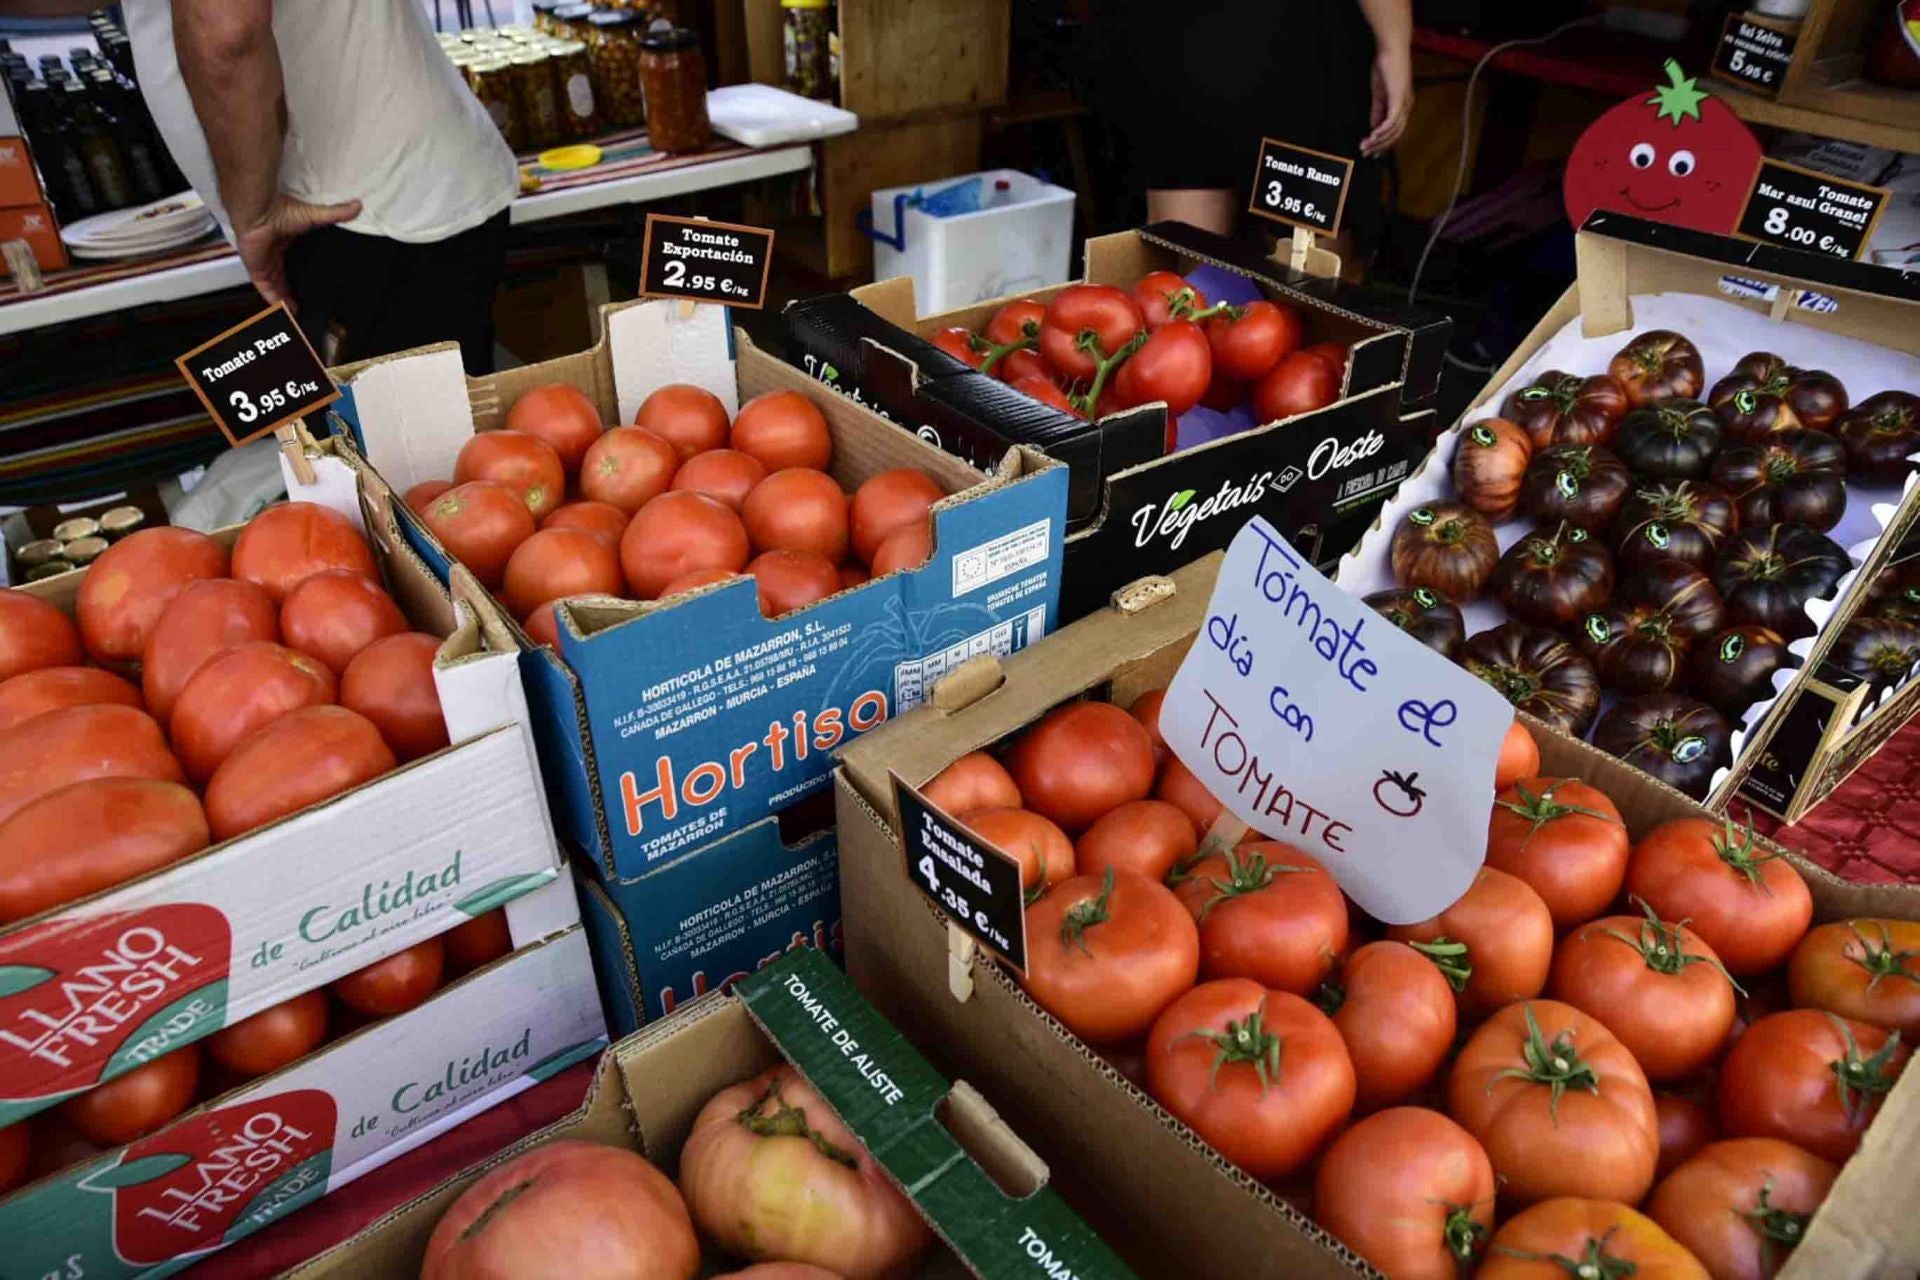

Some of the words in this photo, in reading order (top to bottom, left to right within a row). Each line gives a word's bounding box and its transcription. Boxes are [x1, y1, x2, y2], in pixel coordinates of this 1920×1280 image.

[1265, 155, 1304, 176] Tomate
[1306, 166, 1341, 187] Ramo
[1265, 180, 1302, 213] 3.95
[1818, 185, 1873, 210] Tomate
[1758, 183, 1785, 199] Mar
[1786, 194, 1816, 210] azul
[1818, 202, 1868, 224] Granel
[1764, 207, 1816, 245] 8.00
[662, 242, 754, 264] Exportación
[682, 228, 739, 247] Tomate
[663, 260, 716, 290] 2.95
[202, 349, 257, 383] Tomate
[253, 331, 291, 355] Pera
[229, 388, 286, 422] 3.95
[1131, 472, 1273, 550] Vegetais
[1306, 429, 1386, 481] Oeste
[641, 664, 714, 702] HORTICOLA
[714, 655, 733, 672] DE
[734, 628, 803, 664] MAZARRON,
[804, 620, 826, 636] S.L.
[620, 715, 660, 738] CAÑADA
[660, 708, 674, 721] DE
[674, 691, 717, 715] GALLEGO
[654, 705, 717, 740] MAZARRON
[726, 685, 768, 709] MURCIA
[776, 663, 817, 688] ESPAÑA
[1269, 685, 1314, 742] con
[1397, 699, 1457, 747] el
[768, 774, 827, 806] PRODUCIDO
[1200, 688, 1353, 852] TOMATE
[640, 816, 706, 853] TOMATES
[709, 807, 728, 822] DE
[647, 818, 724, 862] MAZARRON
[922, 811, 985, 869] Tomate
[918, 854, 970, 918] 4.35
[920, 828, 993, 895] Ensalada
[251, 941, 284, 968] de
[298, 850, 462, 943] Calidad
[679, 894, 742, 931] HORTICOLA
[743, 885, 759, 900] DE
[690, 925, 745, 959] MAZARRON
[752, 904, 790, 928] MURCIA
[0, 926, 165, 1051] LLANO
[29, 945, 203, 1068] FRESH
[123, 998, 213, 1063] TRADE
[783, 973, 840, 1033] TOMATE
[831, 1029, 860, 1057] DE
[851, 1052, 904, 1106] ALISTE
[351, 1116, 379, 1139] de
[391, 1028, 531, 1113] Calidad
[136, 1112, 283, 1222] LLANO
[168, 1125, 313, 1231] FRESH
[247, 1166, 320, 1223] TRADE
[1017, 1226, 1081, 1280] TOMA
